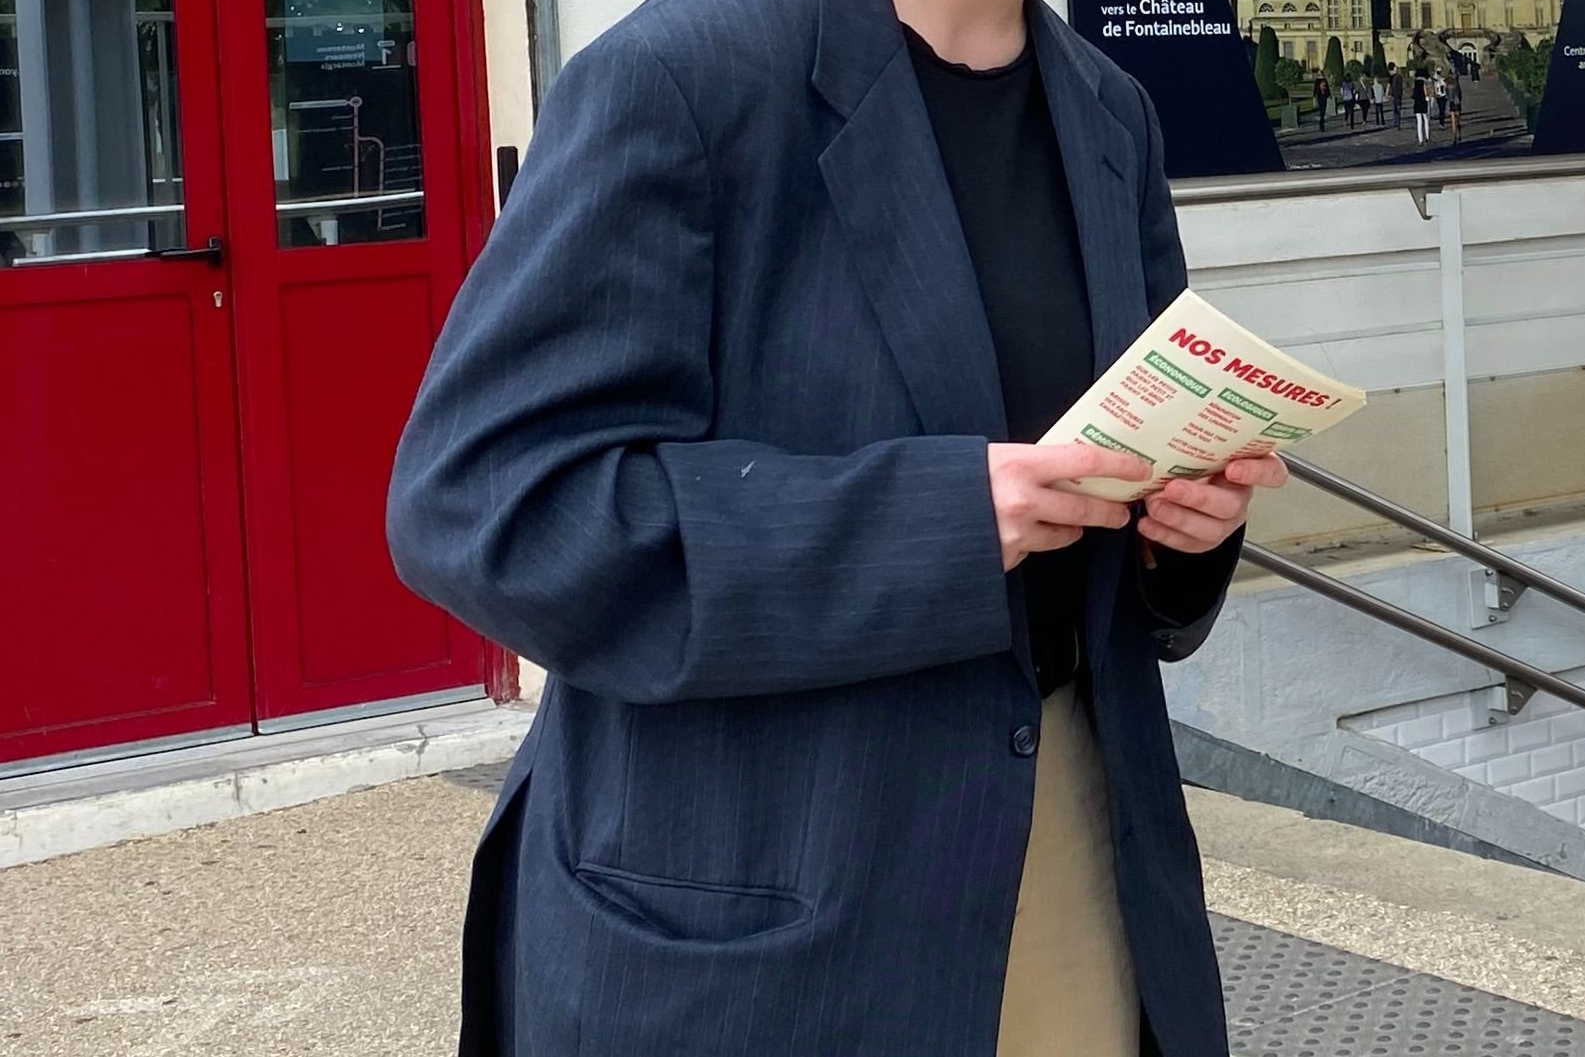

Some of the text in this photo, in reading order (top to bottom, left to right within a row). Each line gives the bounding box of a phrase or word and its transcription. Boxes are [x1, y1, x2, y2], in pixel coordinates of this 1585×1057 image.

[1101, 5, 1124, 15] vers
[1127, 3, 1137, 15] le
[1103, 20, 1231, 37] de Fontainebleau
[1148, 354, 1208, 395] ÉCONOMIQUES
[1168, 327, 1343, 410] NOS MESURES !
